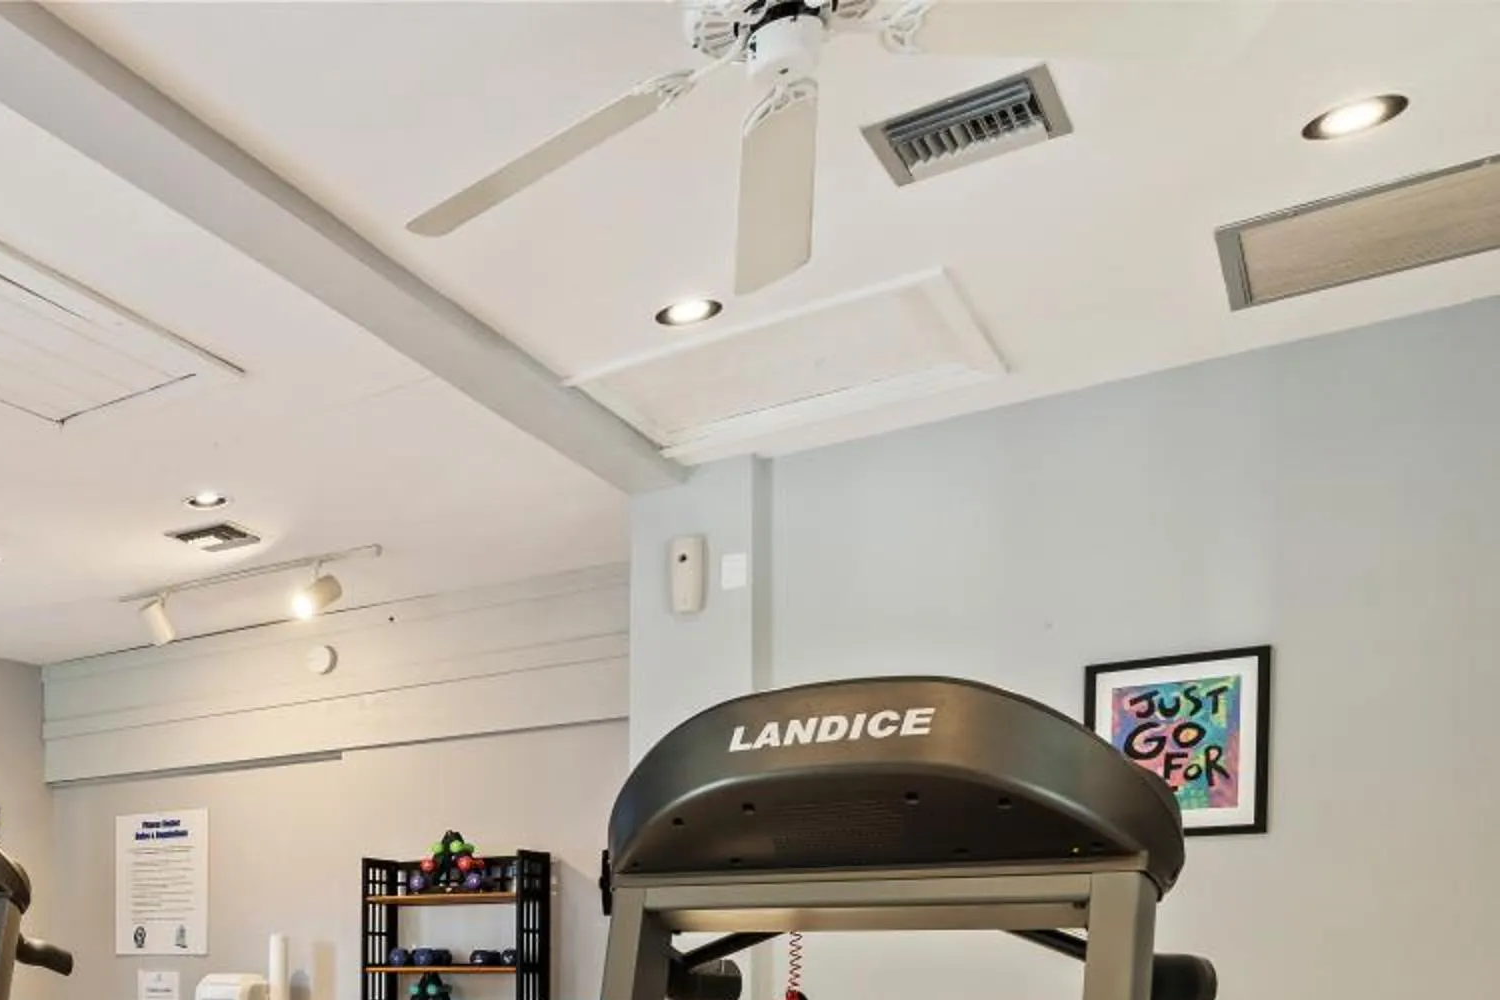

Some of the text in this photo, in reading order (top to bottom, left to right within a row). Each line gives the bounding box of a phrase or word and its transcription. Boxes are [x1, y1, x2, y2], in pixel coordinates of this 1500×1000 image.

[1129, 685, 1228, 718] JUST
[728, 707, 936, 752] LANDICE
[1123, 721, 1206, 760] GO
